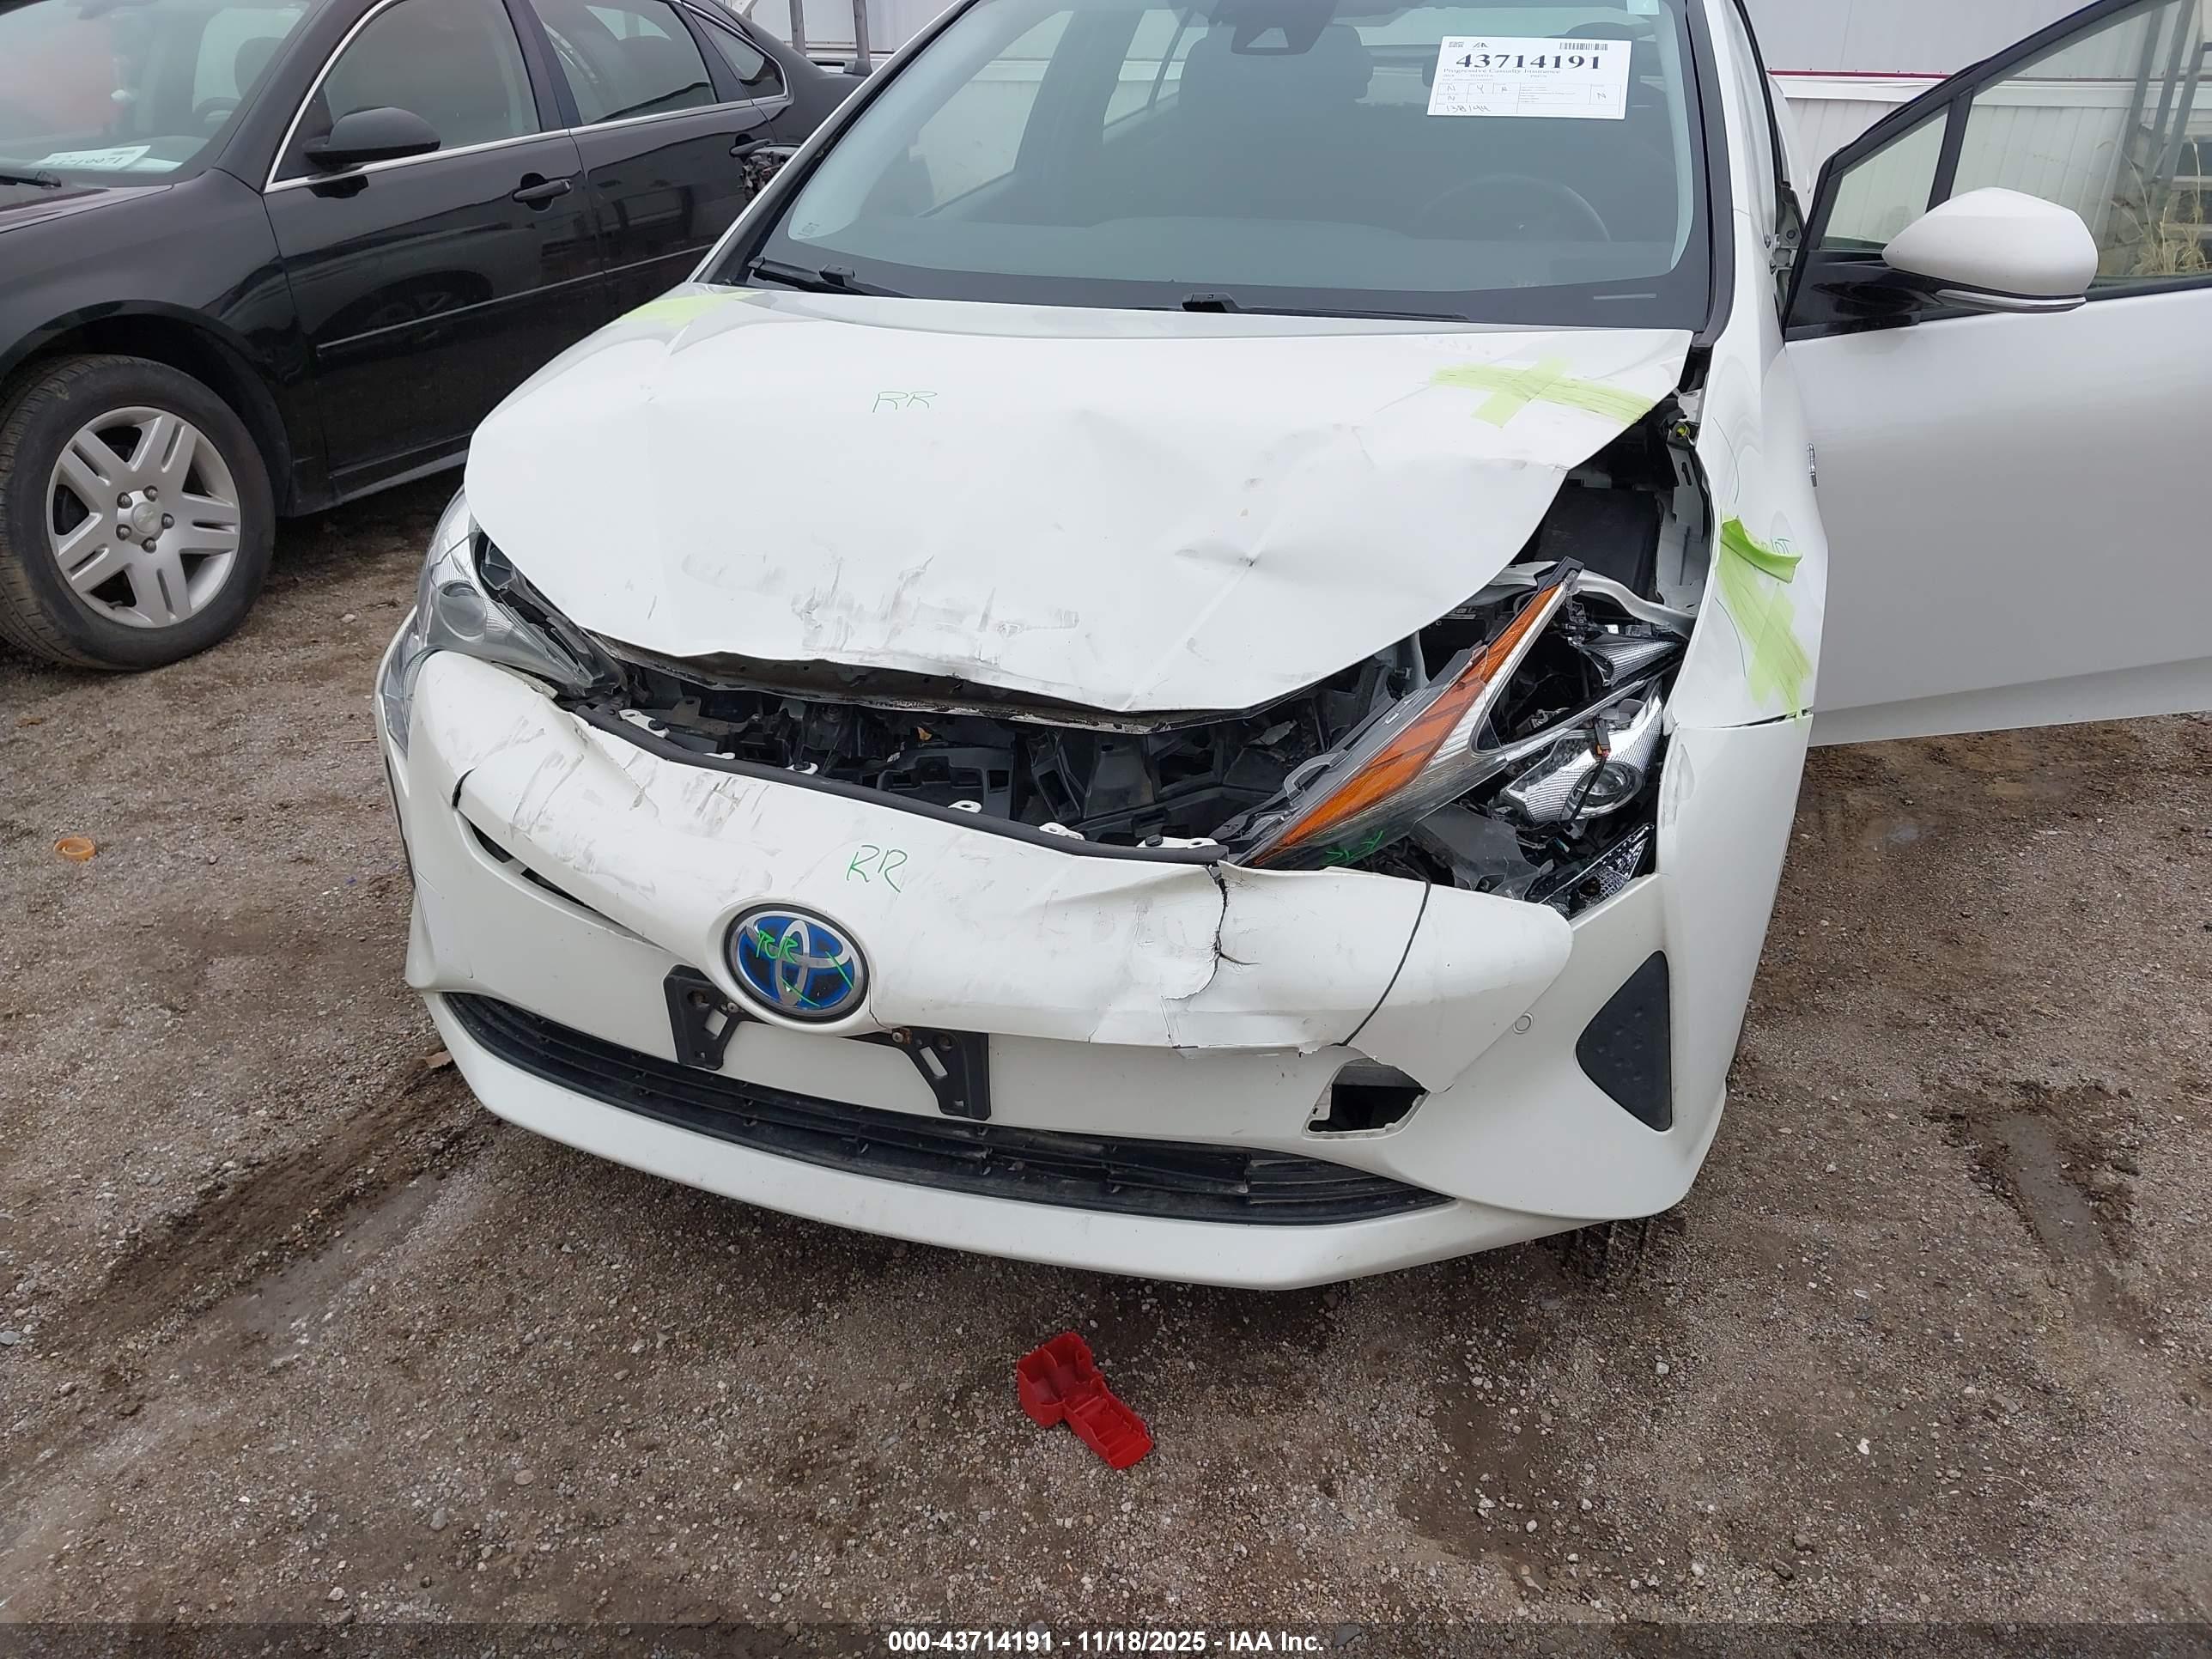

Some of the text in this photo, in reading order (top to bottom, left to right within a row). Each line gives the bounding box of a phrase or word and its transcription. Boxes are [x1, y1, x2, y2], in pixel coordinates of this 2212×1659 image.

[1455, 53, 1601, 70] 43714191
[872, 390, 939, 414] RR
[846, 843, 908, 894] RR
